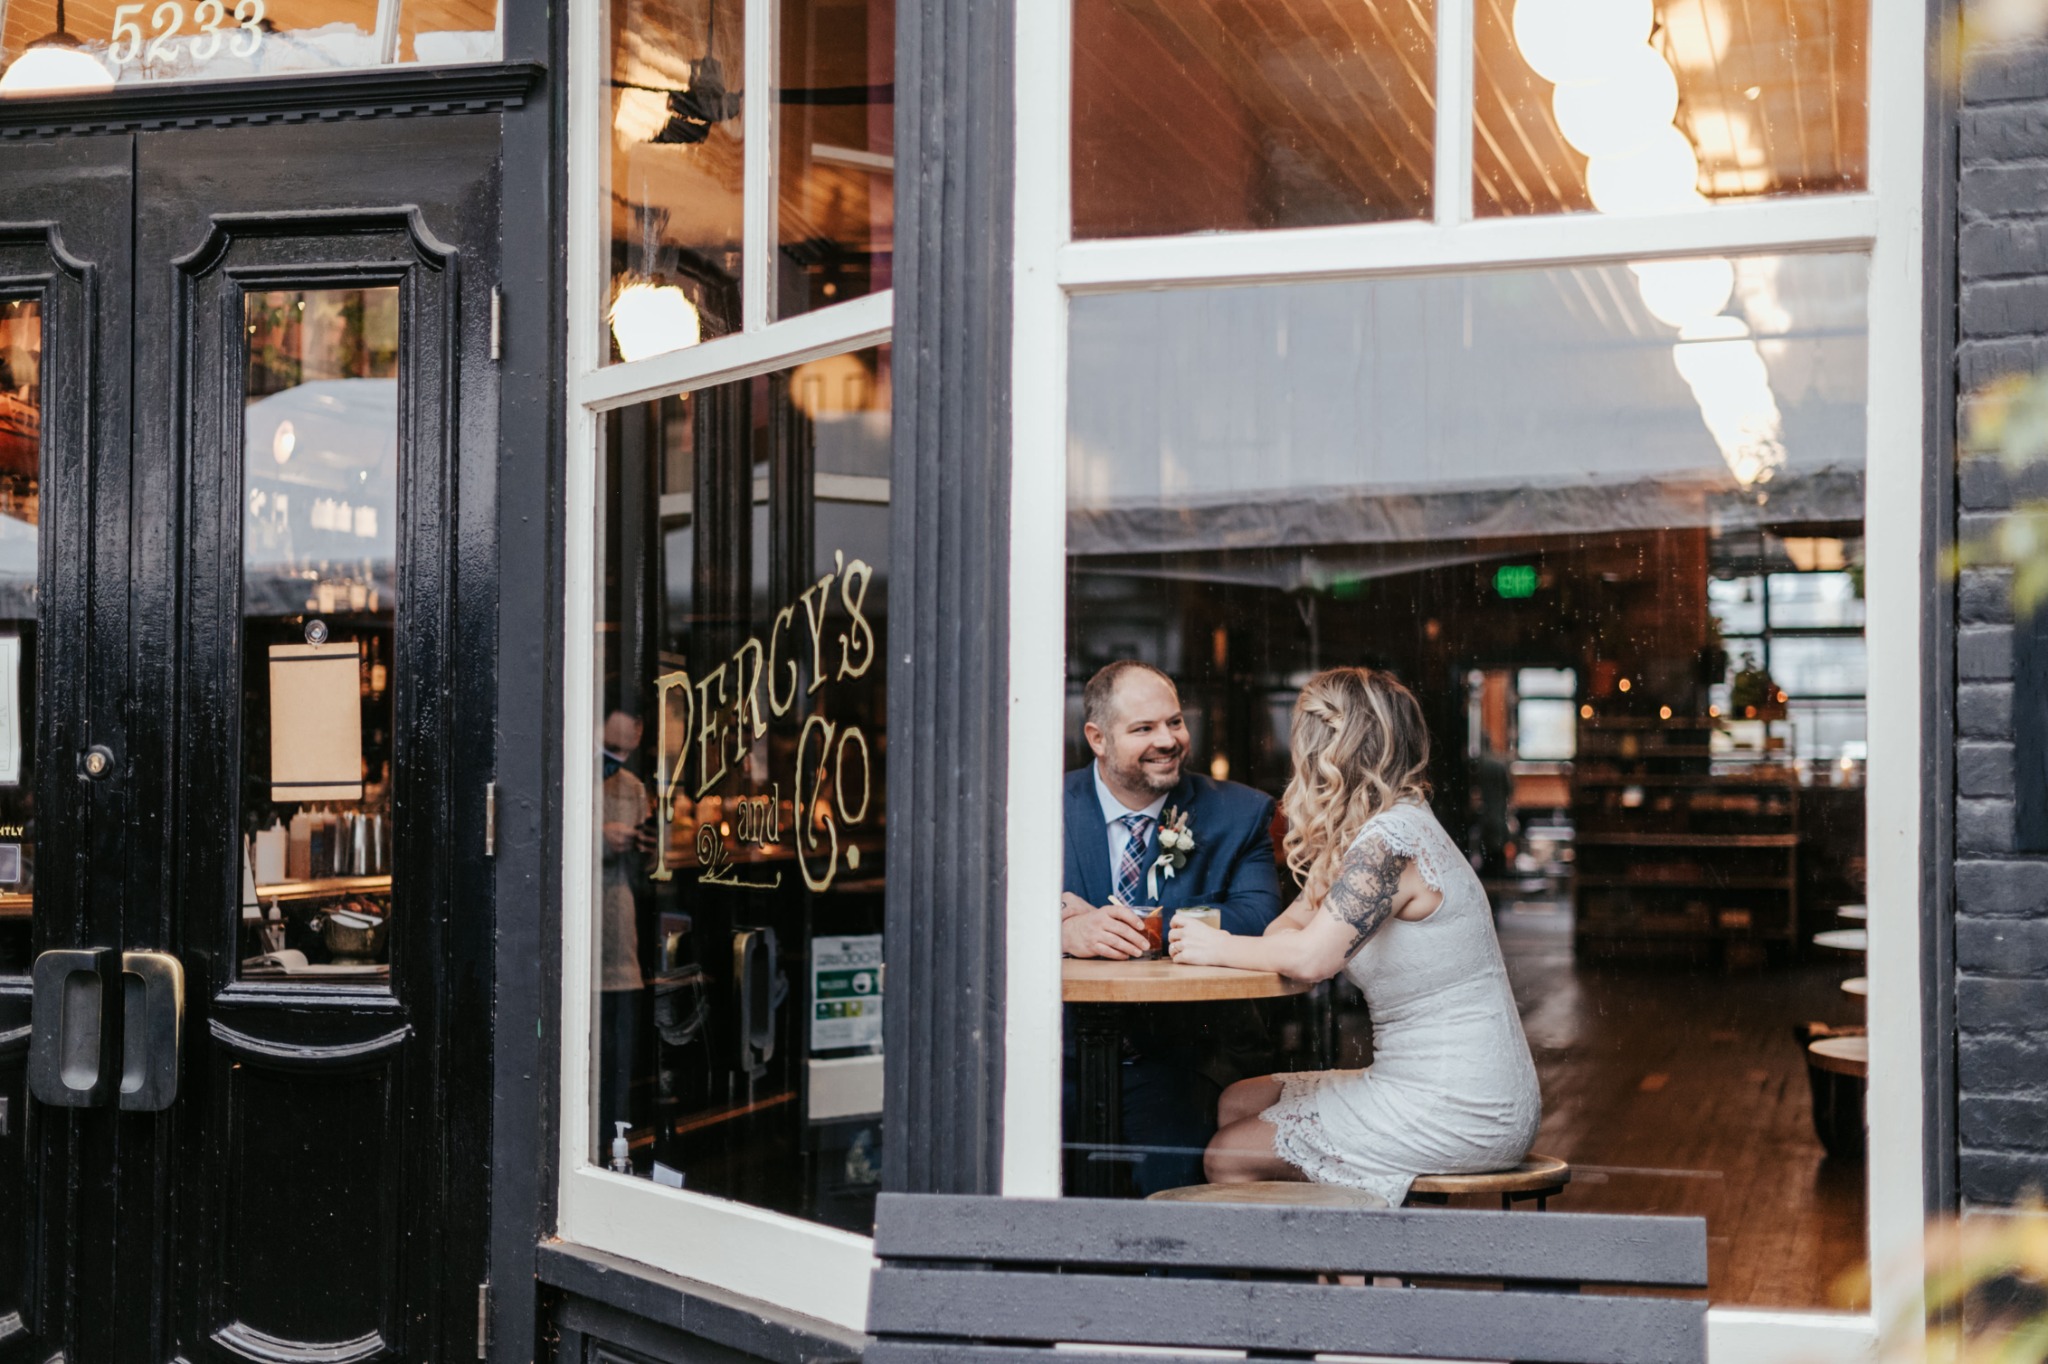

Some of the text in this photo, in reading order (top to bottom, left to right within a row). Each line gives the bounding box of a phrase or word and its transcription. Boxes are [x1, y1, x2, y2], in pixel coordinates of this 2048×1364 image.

[108, 0, 265, 64] 5233
[649, 549, 873, 881] PERCY'S
[737, 715, 869, 892] and Co.
